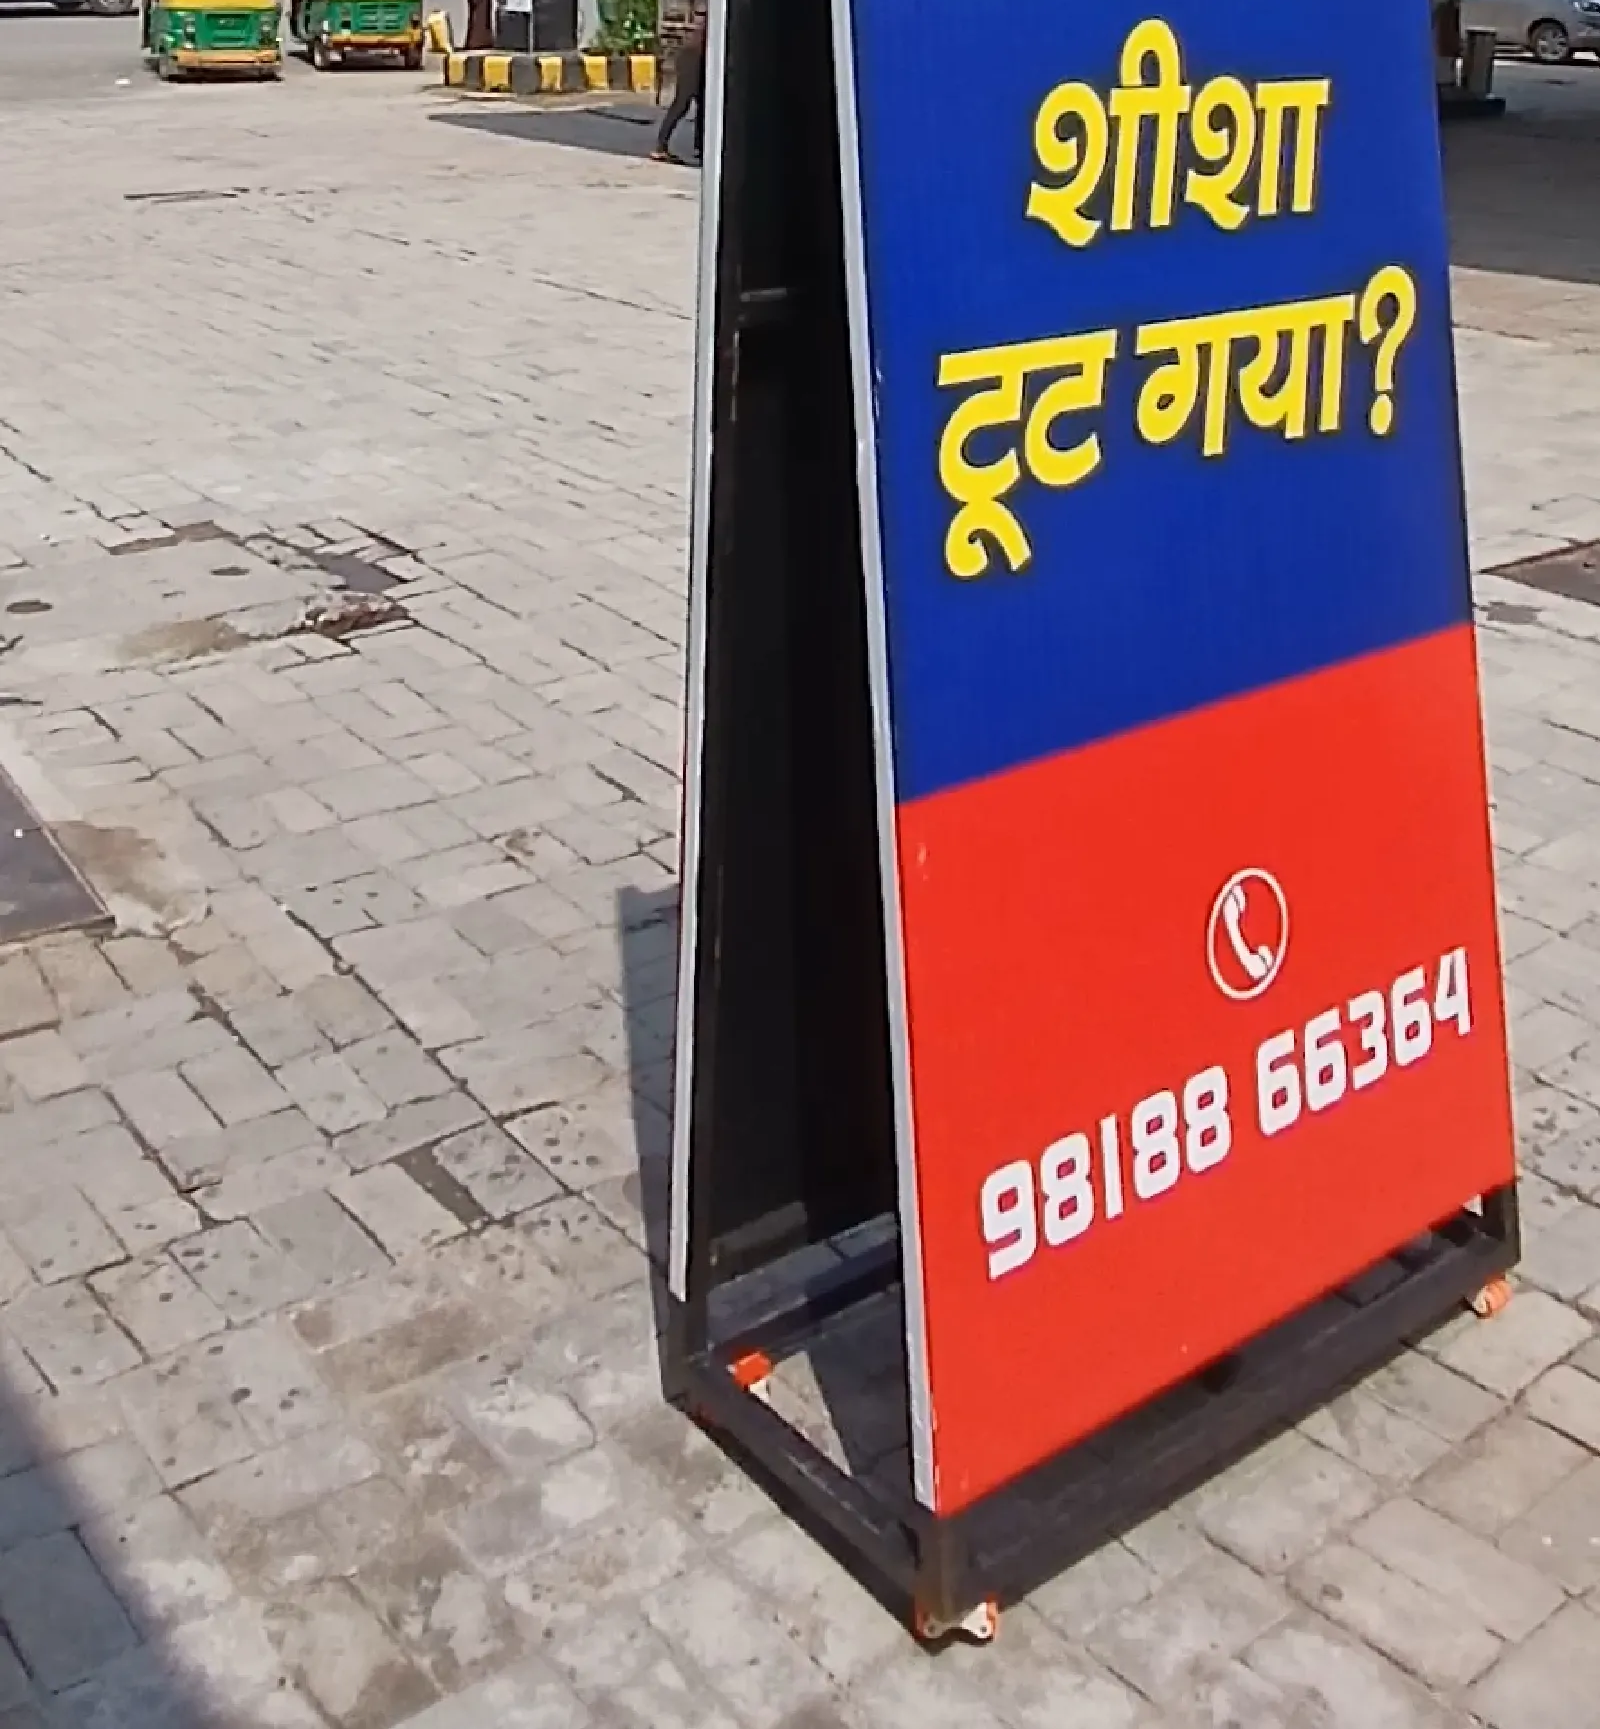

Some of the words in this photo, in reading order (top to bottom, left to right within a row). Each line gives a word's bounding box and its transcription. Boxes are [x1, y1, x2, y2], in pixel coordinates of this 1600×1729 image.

[1026, 18, 1328, 244] शीशा
[936, 331, 1116, 576] टूट
[1134, 266, 1416, 456] गया?
[979, 1062, 1234, 1279] 98188
[1257, 947, 1471, 1136] 66364
